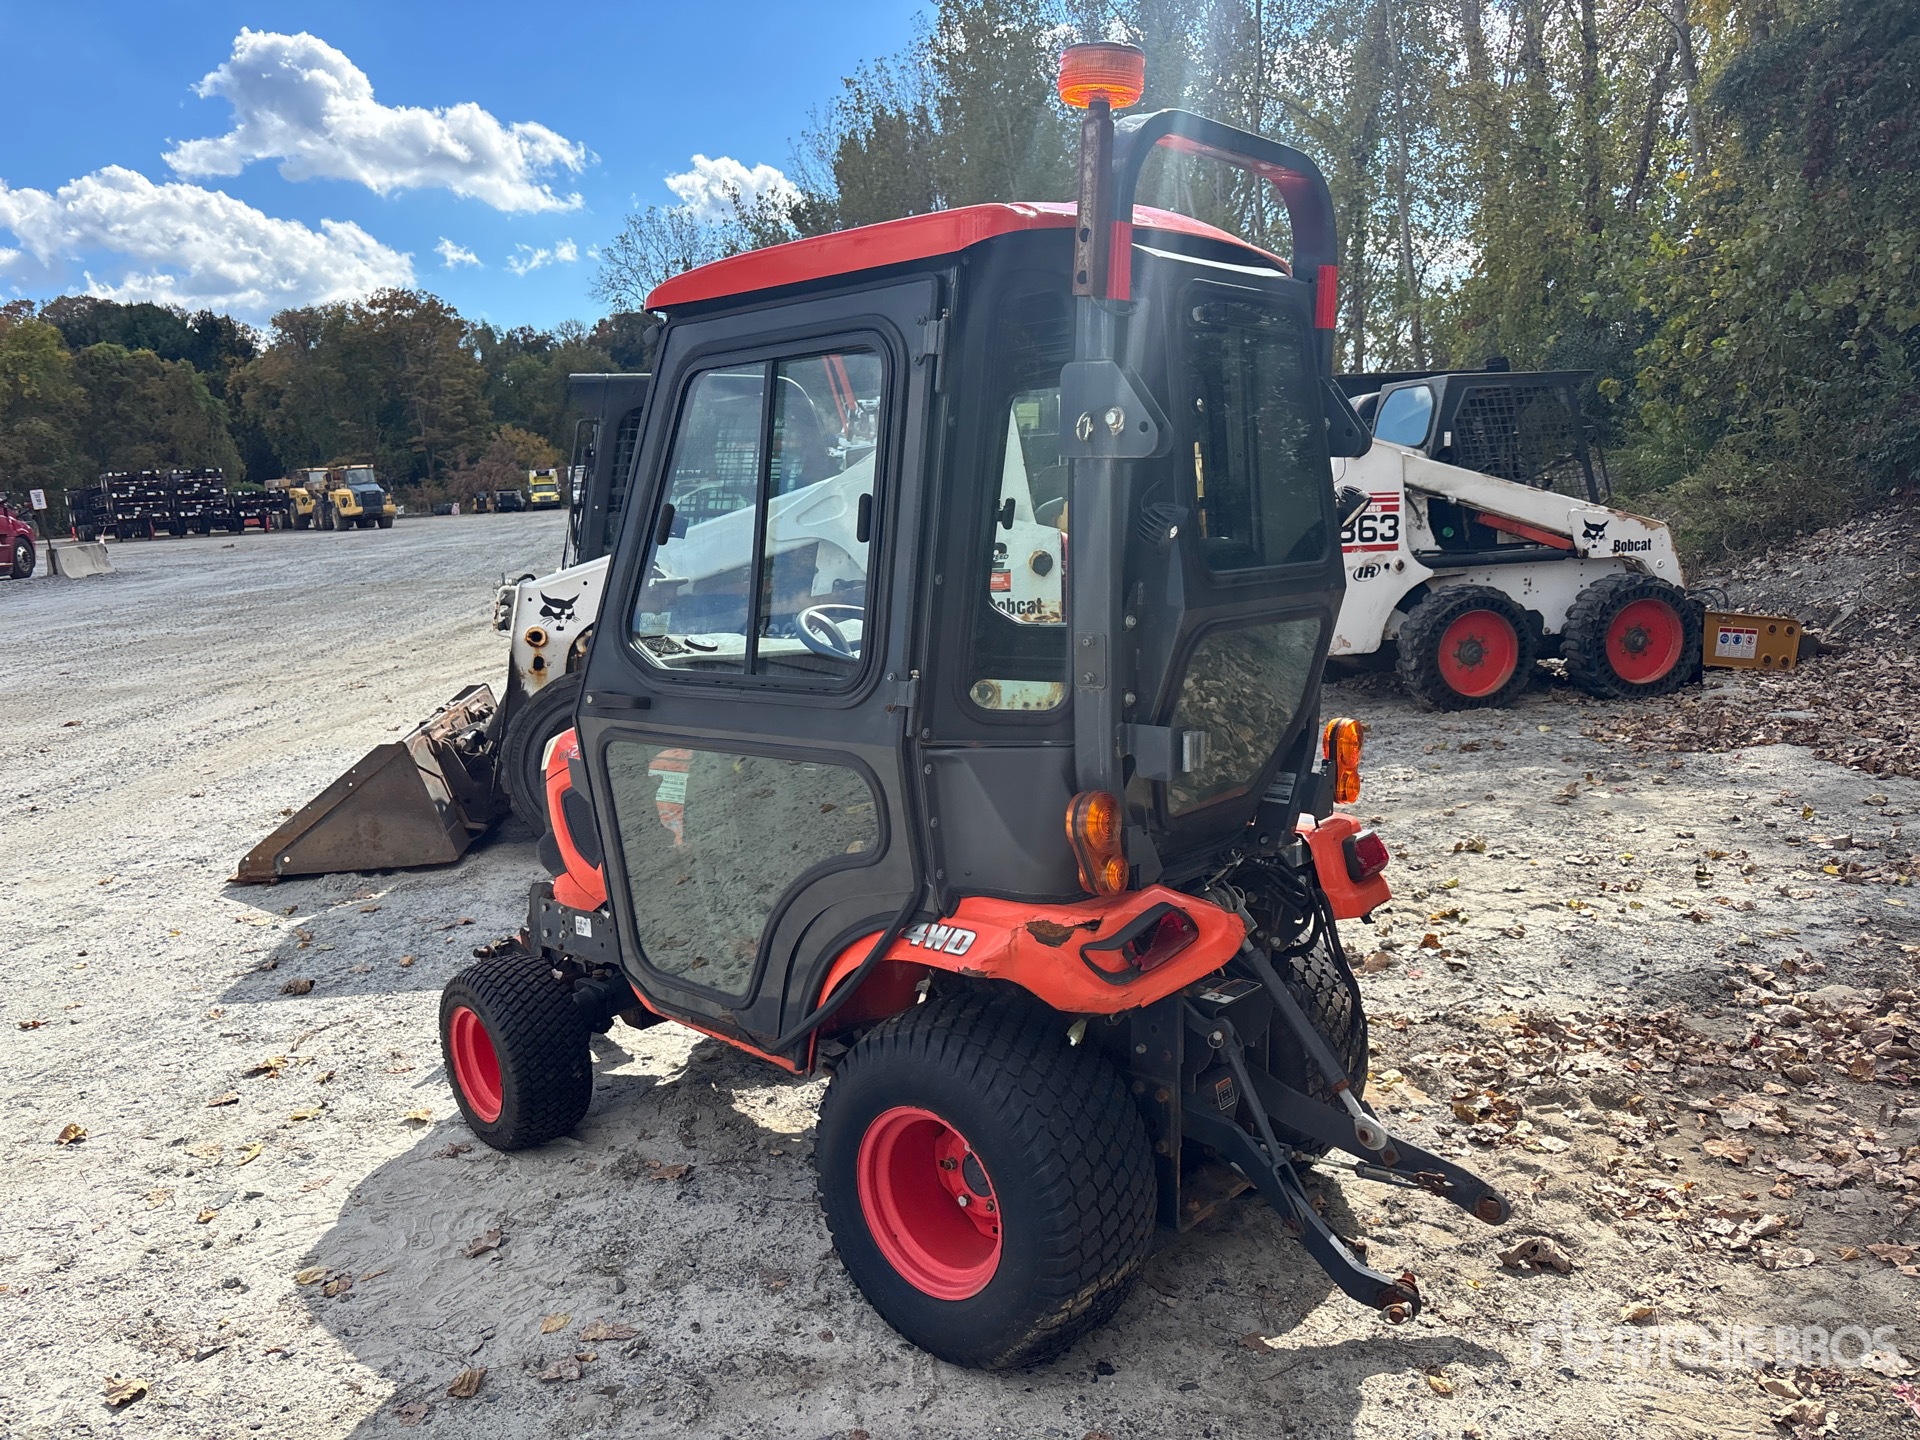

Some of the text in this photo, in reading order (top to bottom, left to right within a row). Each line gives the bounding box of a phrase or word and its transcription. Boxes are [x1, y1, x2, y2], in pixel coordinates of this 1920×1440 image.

[1614, 538, 1652, 552] Bobcat
[1358, 566, 1376, 578] IR
[991, 598, 1043, 614] obcat
[903, 923, 977, 956] 4WD
